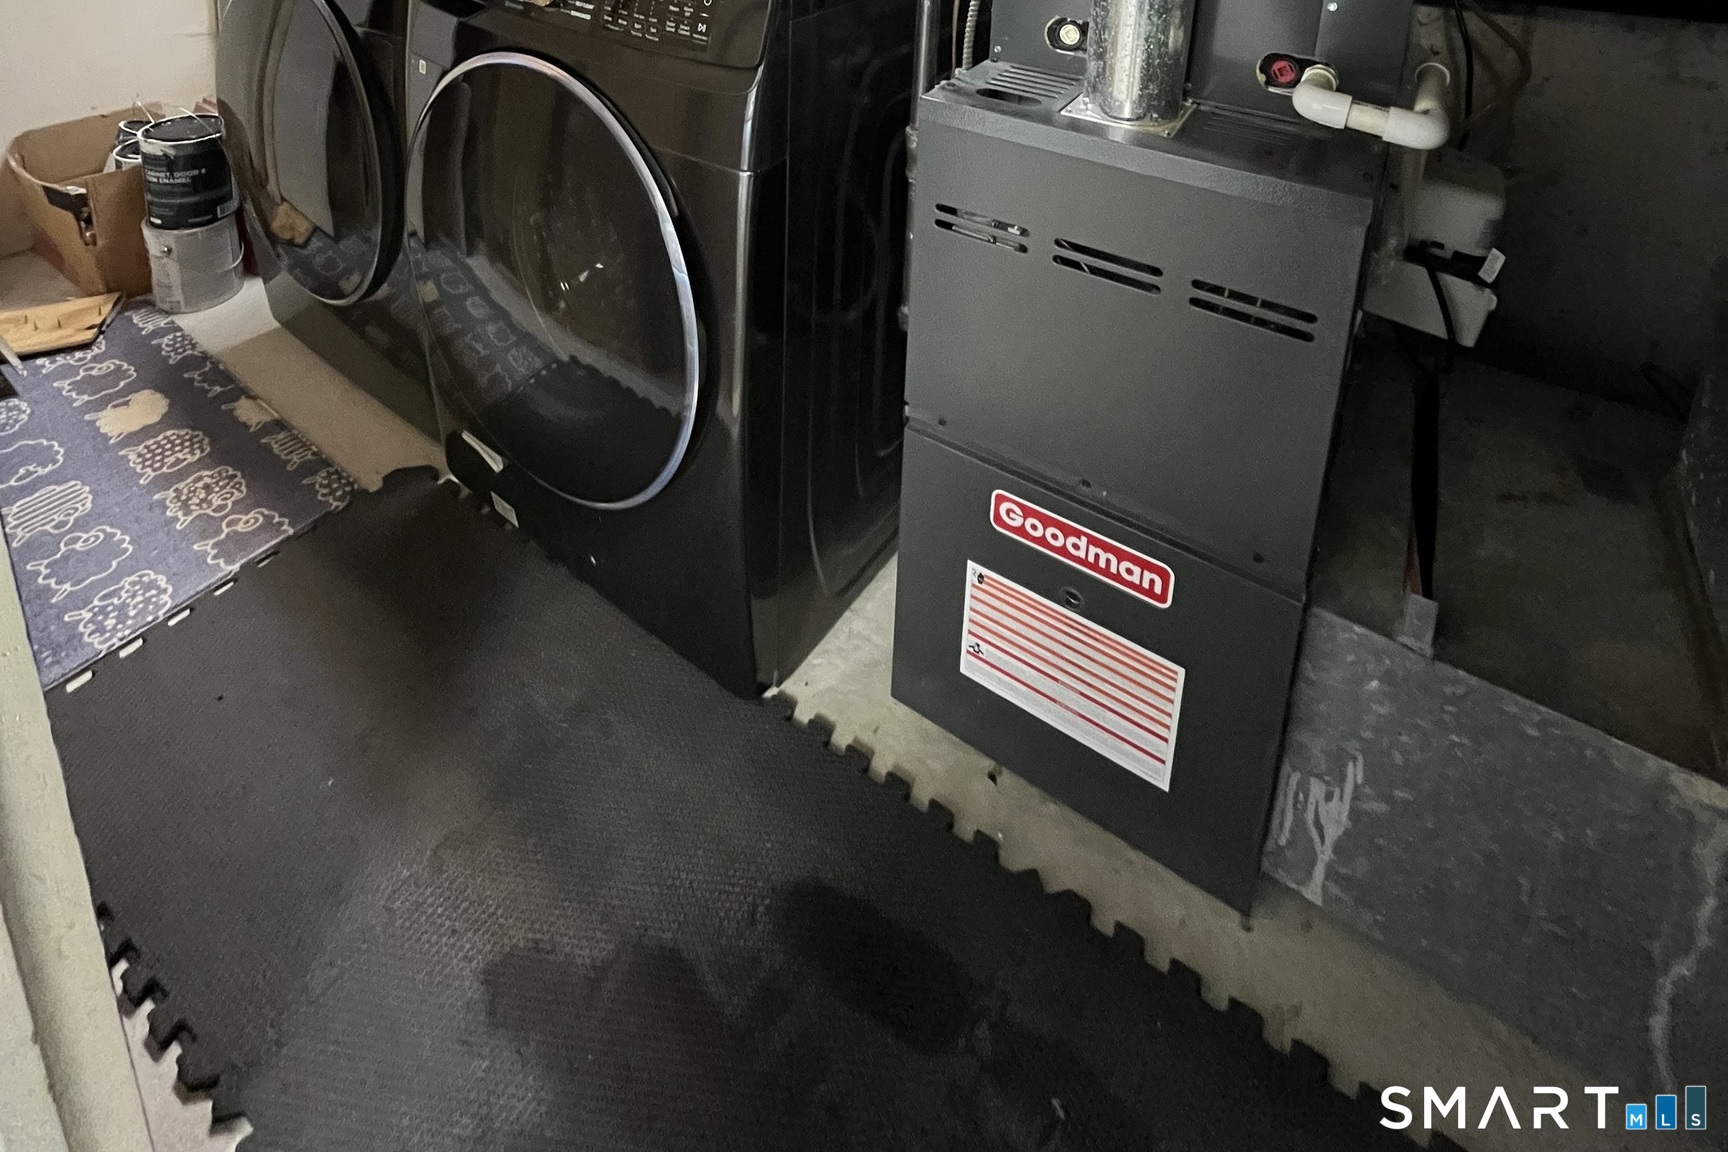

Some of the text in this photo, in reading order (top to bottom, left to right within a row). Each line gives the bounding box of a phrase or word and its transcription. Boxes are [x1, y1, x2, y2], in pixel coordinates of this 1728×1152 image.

[174, 169, 199, 178] DOOR
[159, 176, 192, 184] ENAMEL
[998, 501, 1163, 596] Goodman
